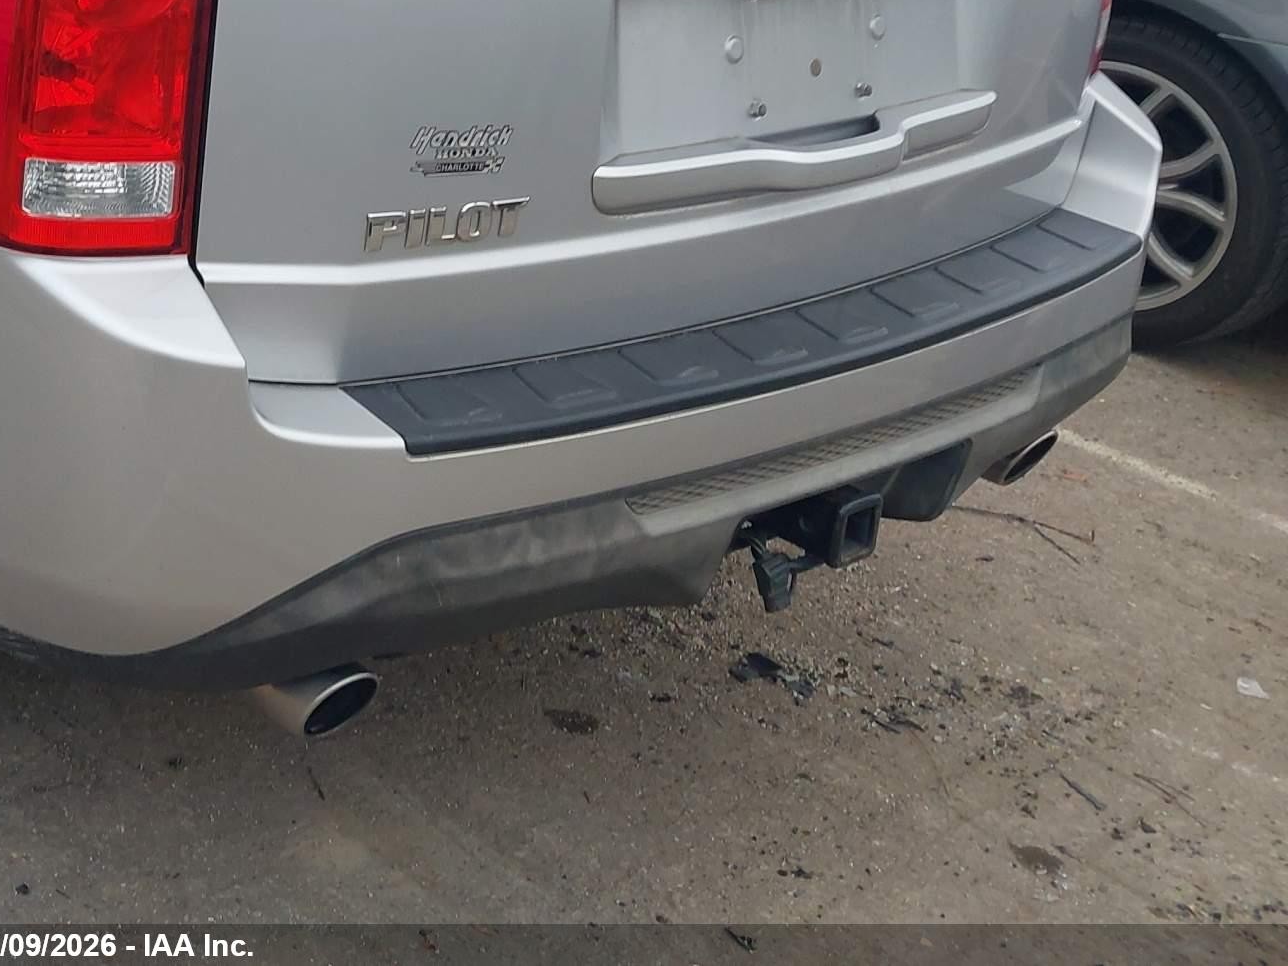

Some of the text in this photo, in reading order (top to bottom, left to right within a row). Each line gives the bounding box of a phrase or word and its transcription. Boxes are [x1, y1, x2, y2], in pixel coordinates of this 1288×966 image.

[410, 125, 513, 155] Hendrick
[435, 147, 499, 159] HONDA
[435, 162, 486, 172] CHARLOTTE
[364, 196, 530, 251] PILOT
